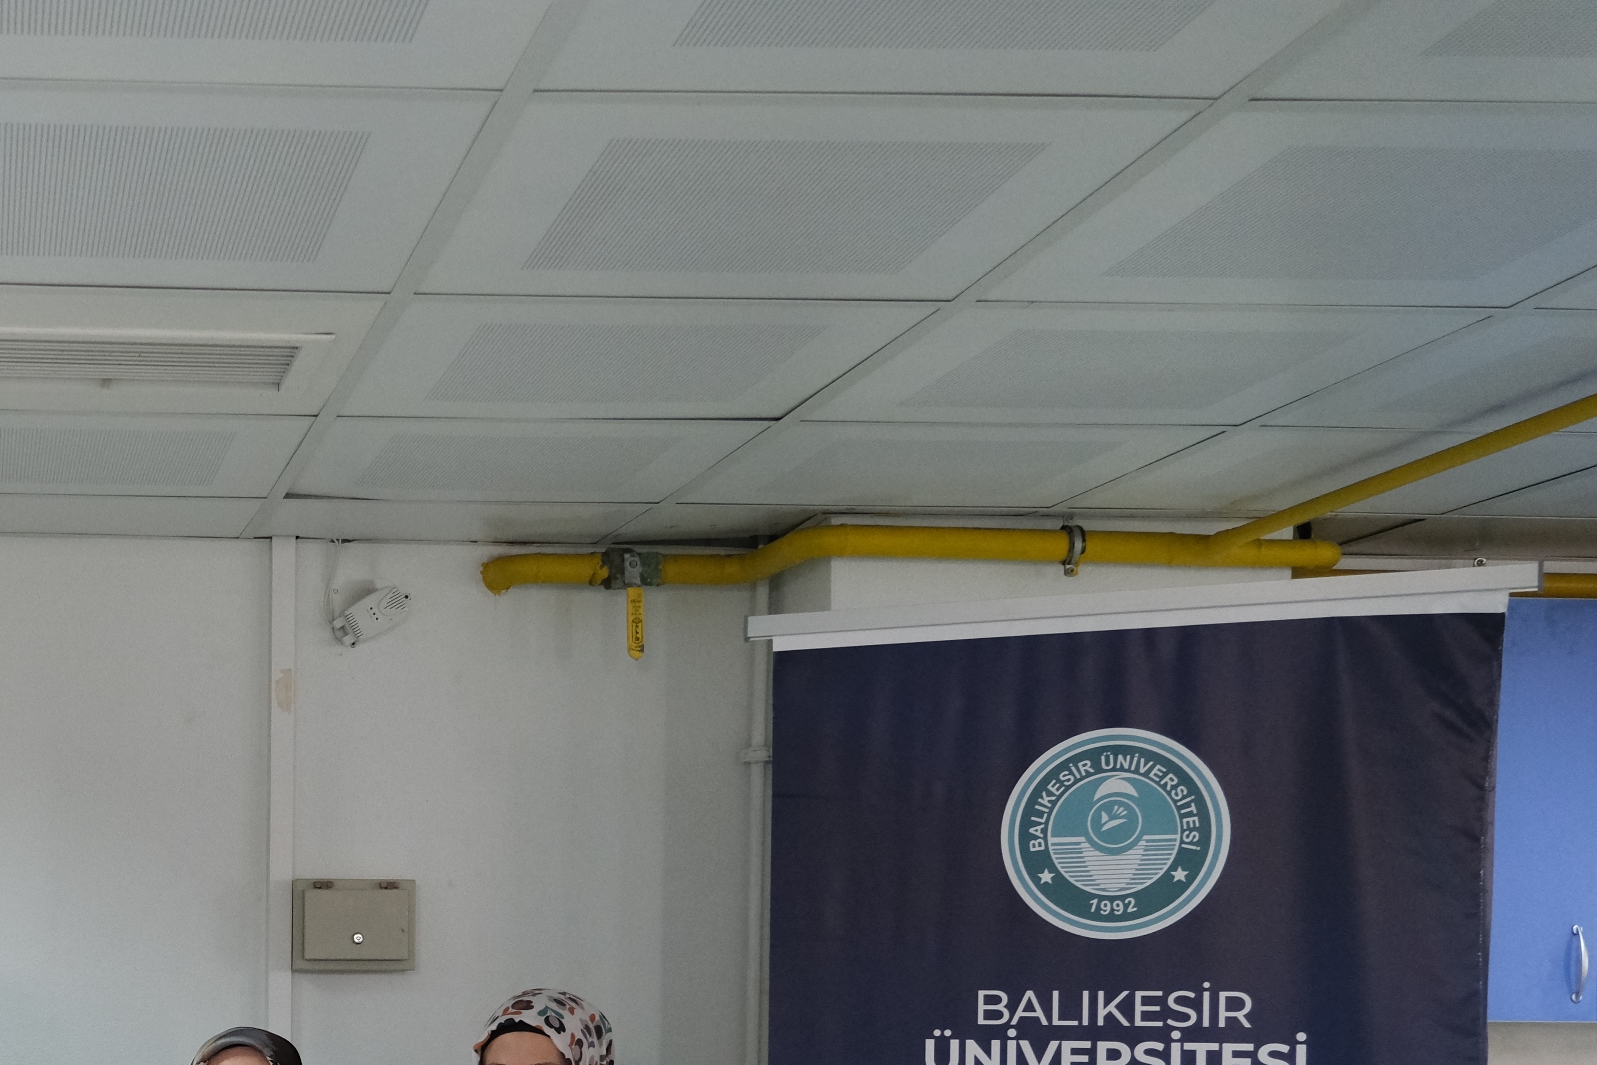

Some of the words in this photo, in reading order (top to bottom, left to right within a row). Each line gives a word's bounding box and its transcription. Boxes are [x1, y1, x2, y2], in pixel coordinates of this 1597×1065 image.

[1029, 759, 1095, 852] BALIKESİR
[1100, 752, 1201, 851] ÜNİVERSİTESİ
[1088, 897, 1138, 915] 1992
[977, 981, 1253, 1028] BALIKESİR
